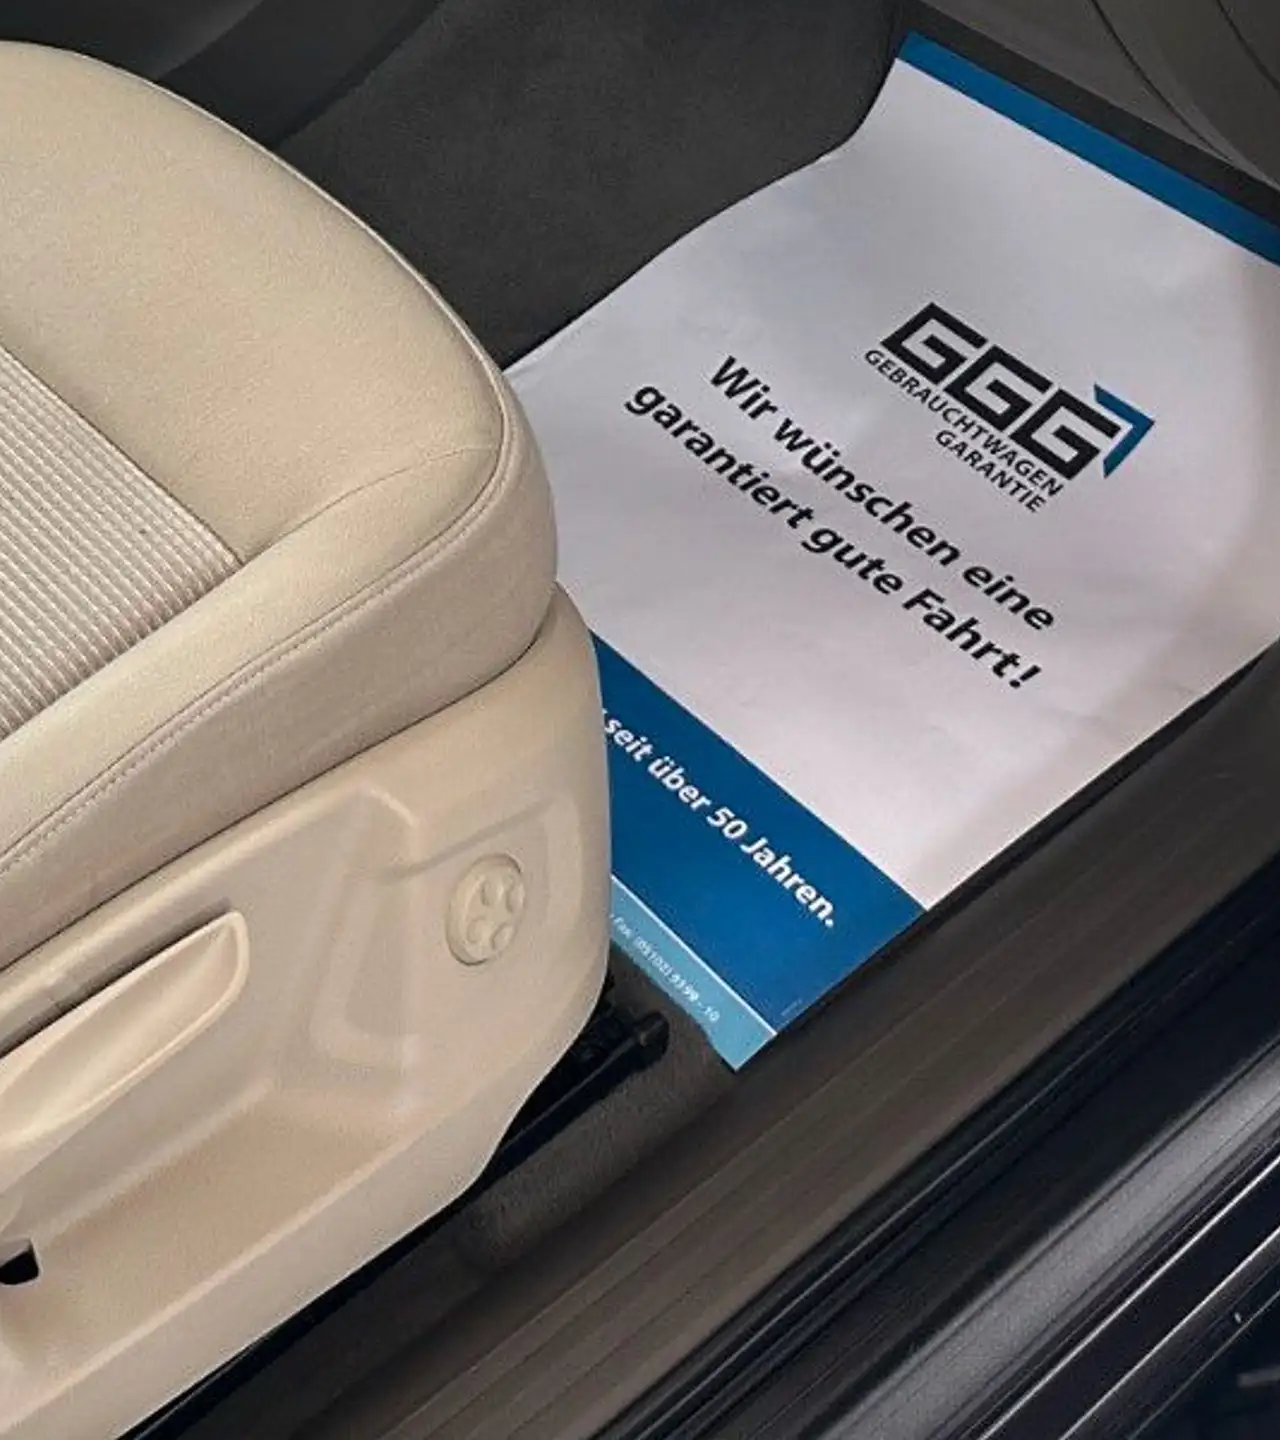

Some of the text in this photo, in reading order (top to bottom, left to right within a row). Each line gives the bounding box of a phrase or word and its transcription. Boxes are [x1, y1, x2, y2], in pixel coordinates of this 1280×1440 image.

[864, 349, 1064, 497] GEBRAUCHTWAGEN
[880, 302, 1122, 480] GGG
[935, 429, 1046, 513] GARANTIE
[624, 386, 1041, 688] garantiert gute Fahrt!
[710, 355, 1054, 630] Wir wünschen eine
[604, 719, 834, 928] seit über 50 Jahren.
